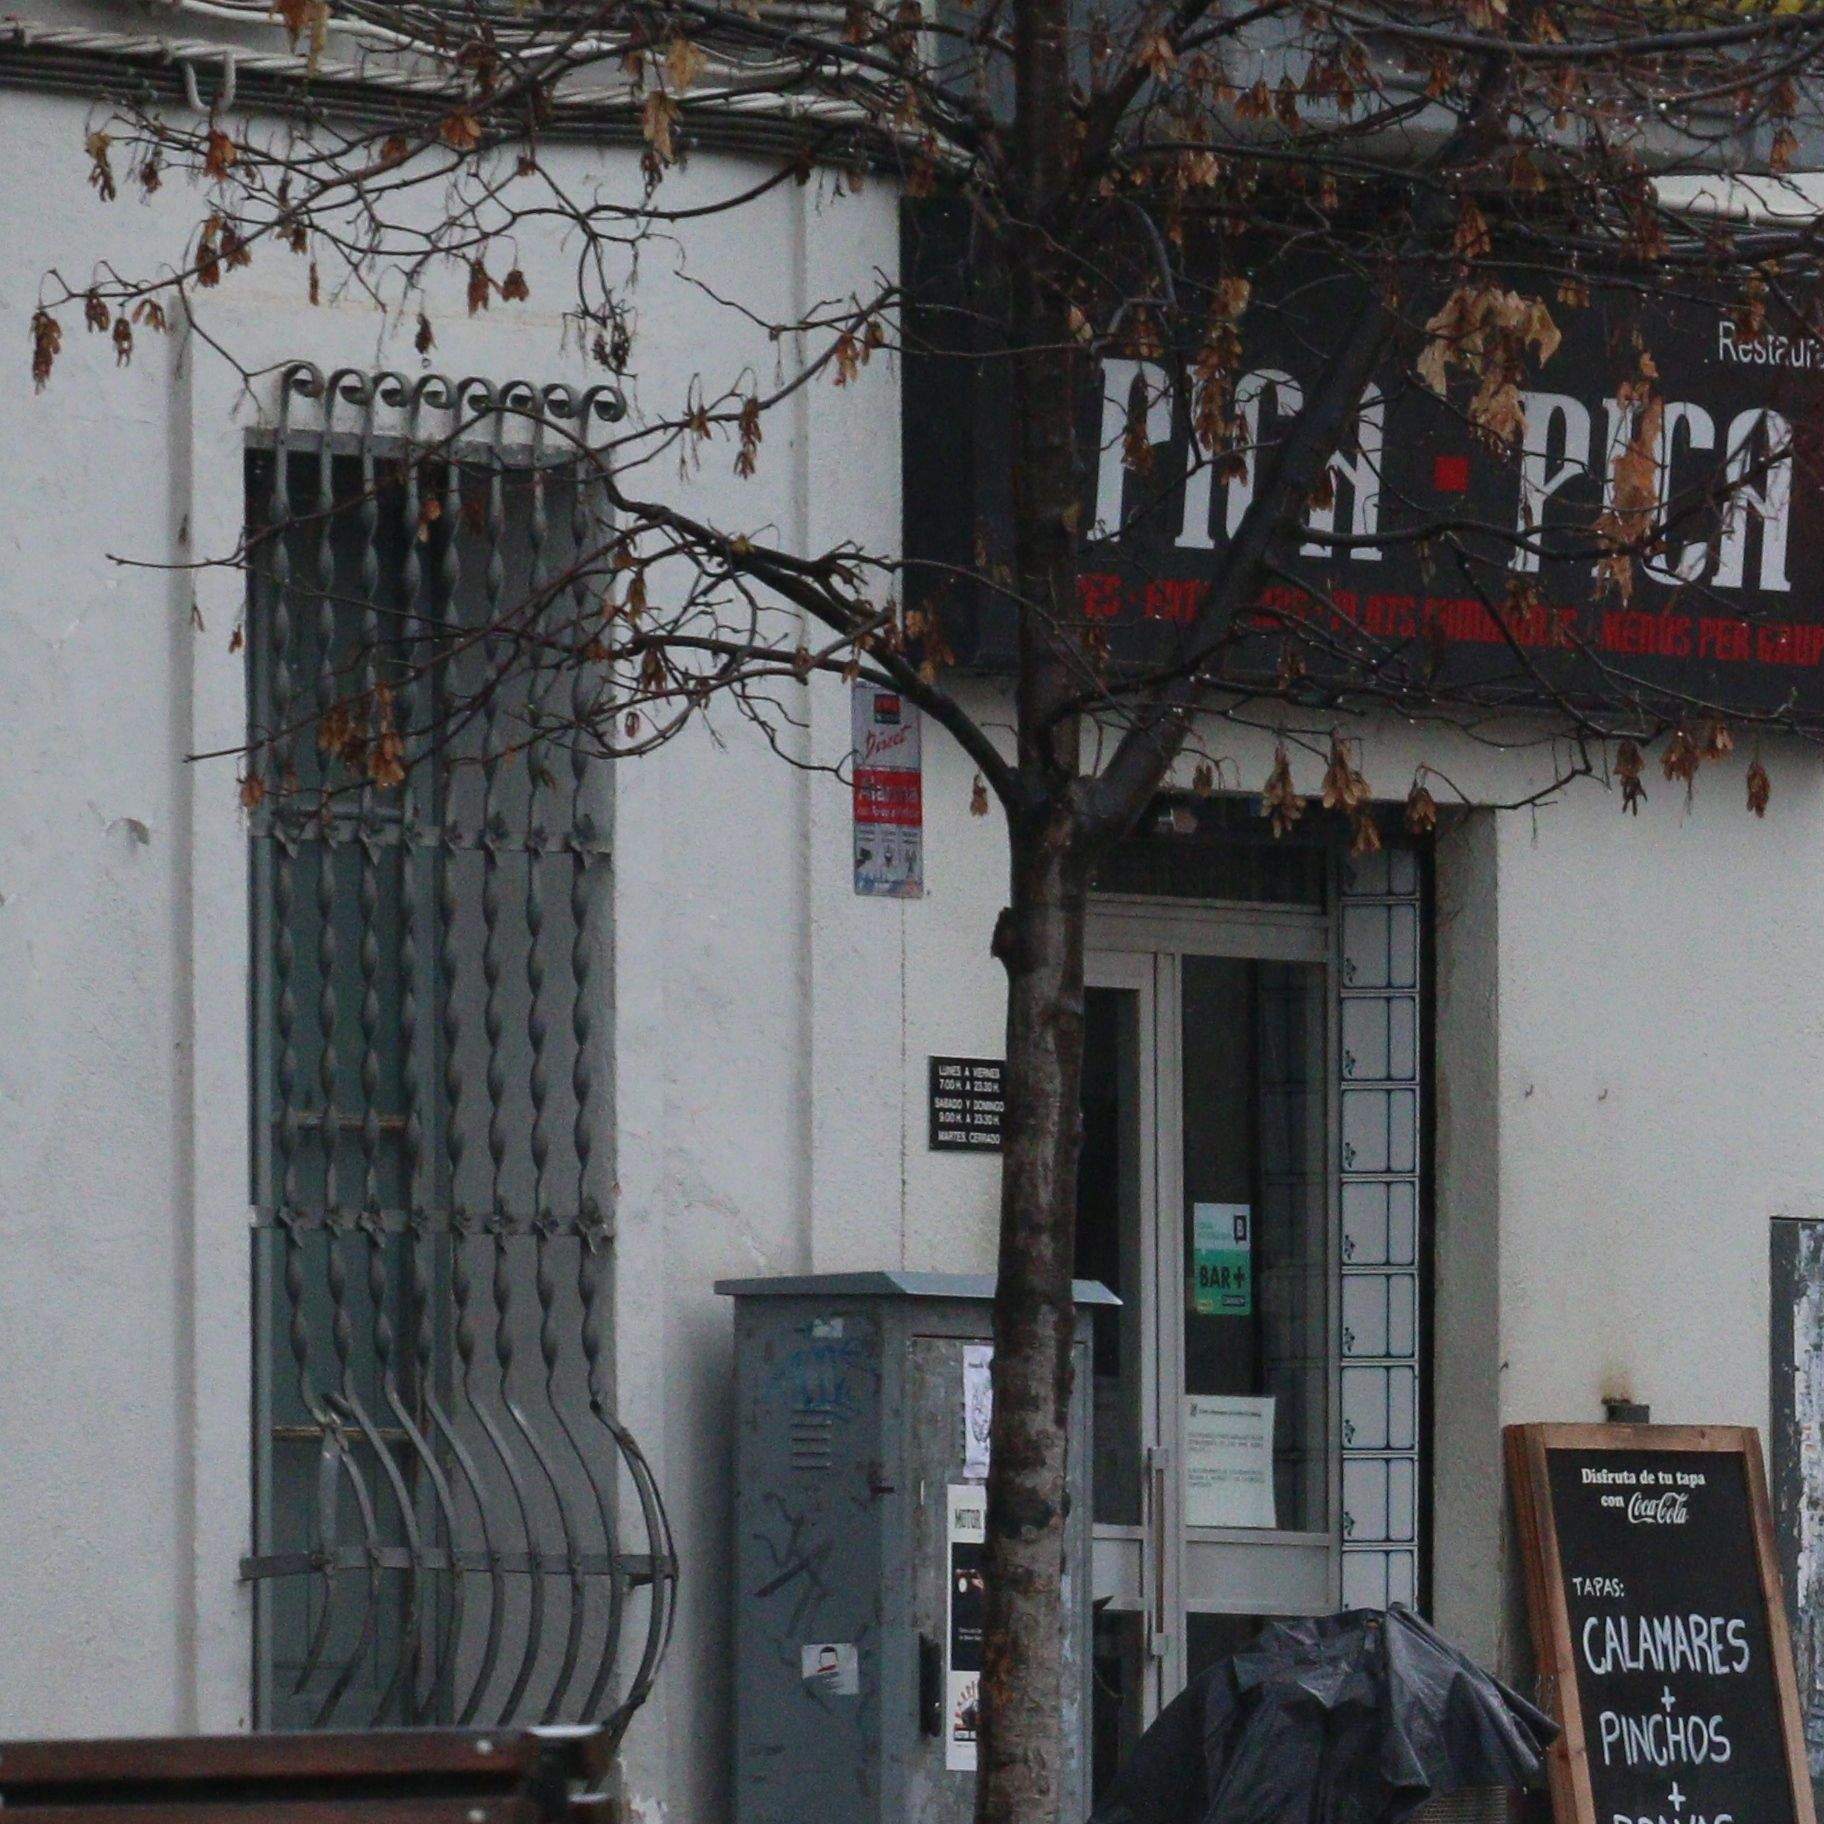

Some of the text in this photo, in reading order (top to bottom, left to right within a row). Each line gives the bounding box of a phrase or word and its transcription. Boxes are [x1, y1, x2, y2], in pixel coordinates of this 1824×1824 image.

[1508, 390, 1793, 592] PICA
[1697, 615, 1751, 663] PER
[964, 1066, 970, 1077] A
[965, 1080, 971, 1090] A
[965, 1113, 971, 1123] A
[1581, 1468, 1706, 1489] Disfruta de tu tapa
[1600, 1494, 1625, 1508] con
[1572, 1576, 1625, 1597] TAPAS:
[1583, 1614, 1750, 1675] CALAMARES
[1599, 1710, 1732, 1767] PINCHOS
